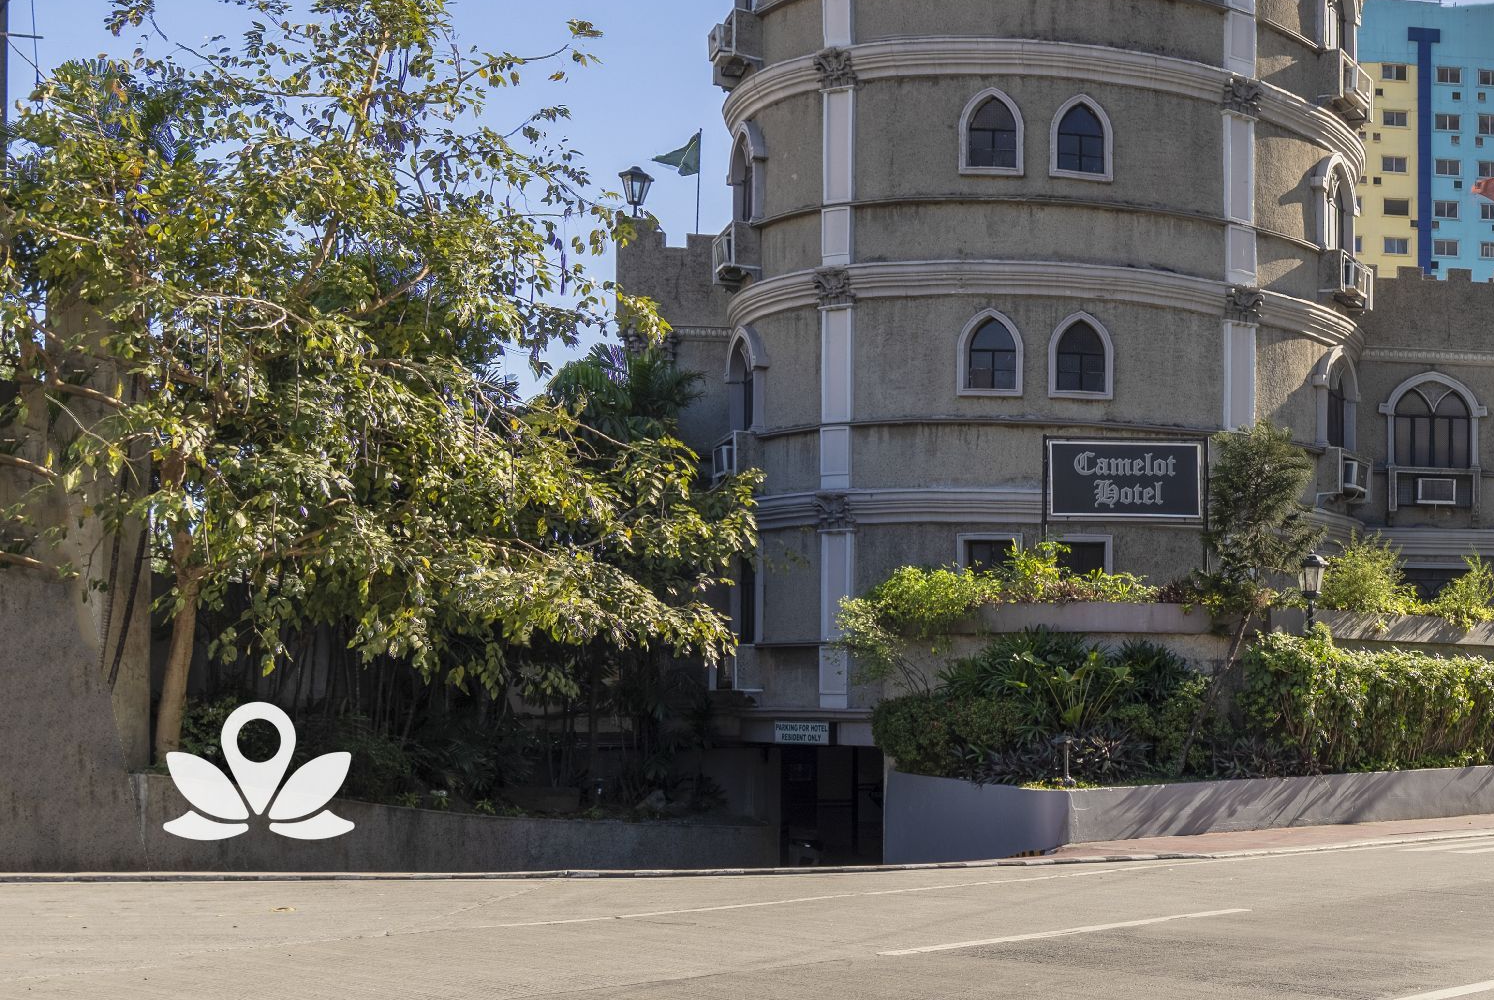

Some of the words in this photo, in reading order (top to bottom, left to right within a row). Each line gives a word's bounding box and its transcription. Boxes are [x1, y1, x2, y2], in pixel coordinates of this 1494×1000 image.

[1073, 451, 1176, 477] Camelot
[1093, 479, 1164, 508] Hotel
[775, 723, 797, 731] PARKING
[799, 724, 810, 732] FOR
[811, 724, 828, 733] HOTEL
[781, 733, 807, 741] RESIDENT
[807, 734, 822, 742] ONLY
